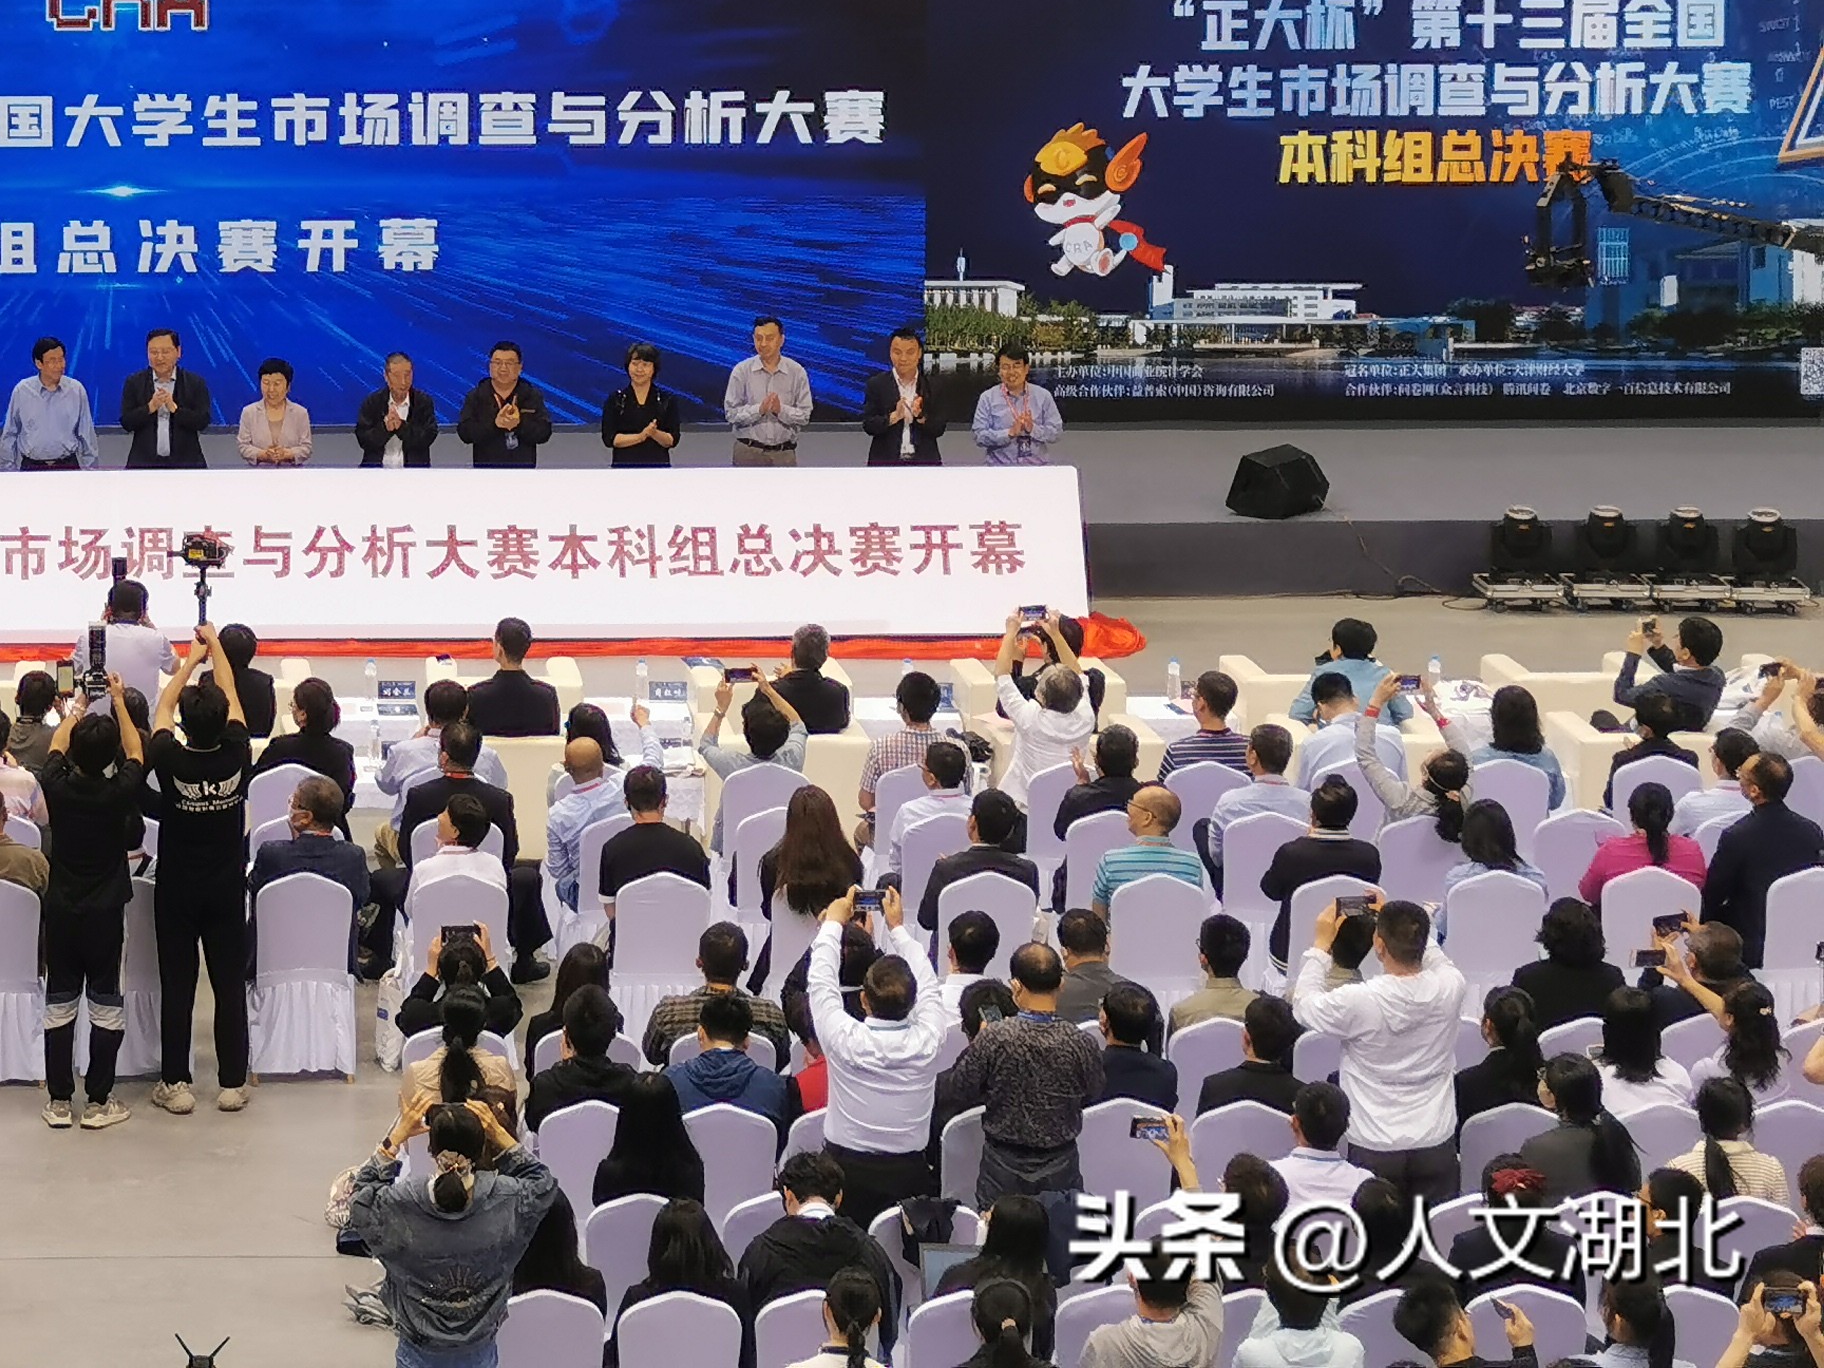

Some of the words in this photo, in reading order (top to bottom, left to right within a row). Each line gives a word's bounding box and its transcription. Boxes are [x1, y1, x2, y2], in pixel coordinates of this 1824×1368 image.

[1121, 61, 1753, 120] 大学生市场调查与分析大赛
[1279, 129, 1592, 185] 本科组总决赛
